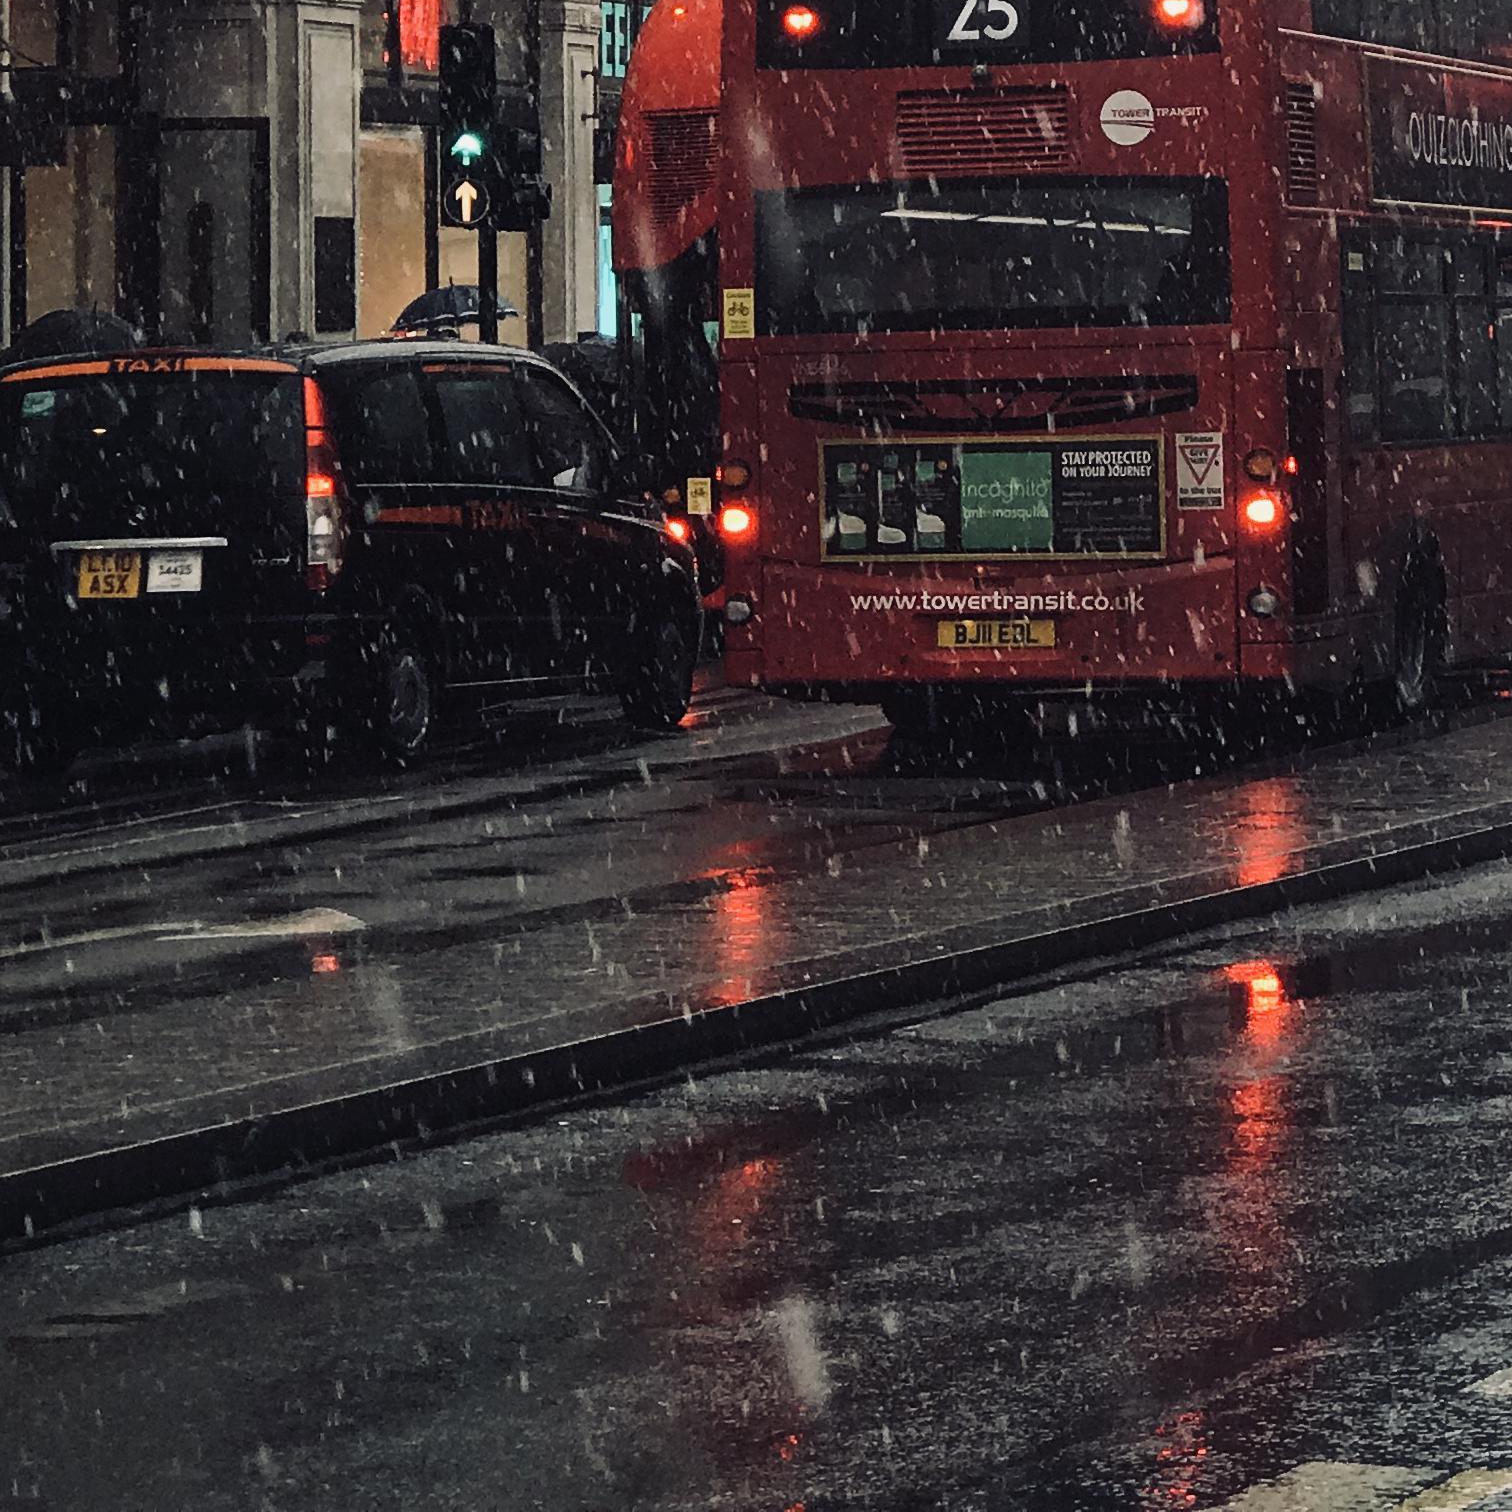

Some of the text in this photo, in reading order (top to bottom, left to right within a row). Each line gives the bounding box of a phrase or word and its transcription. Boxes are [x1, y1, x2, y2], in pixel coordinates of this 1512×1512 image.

[1112, 107, 1201, 118] TOWER TRANSIT
[113, 358, 183, 373] TAXI
[1062, 451, 1151, 465] STAY PROTECTED
[1062, 464, 1152, 478] ON YOUR JOURNEY
[88, 574, 131, 594] ASX
[851, 590, 1145, 611] www.towertransit.co.uk
